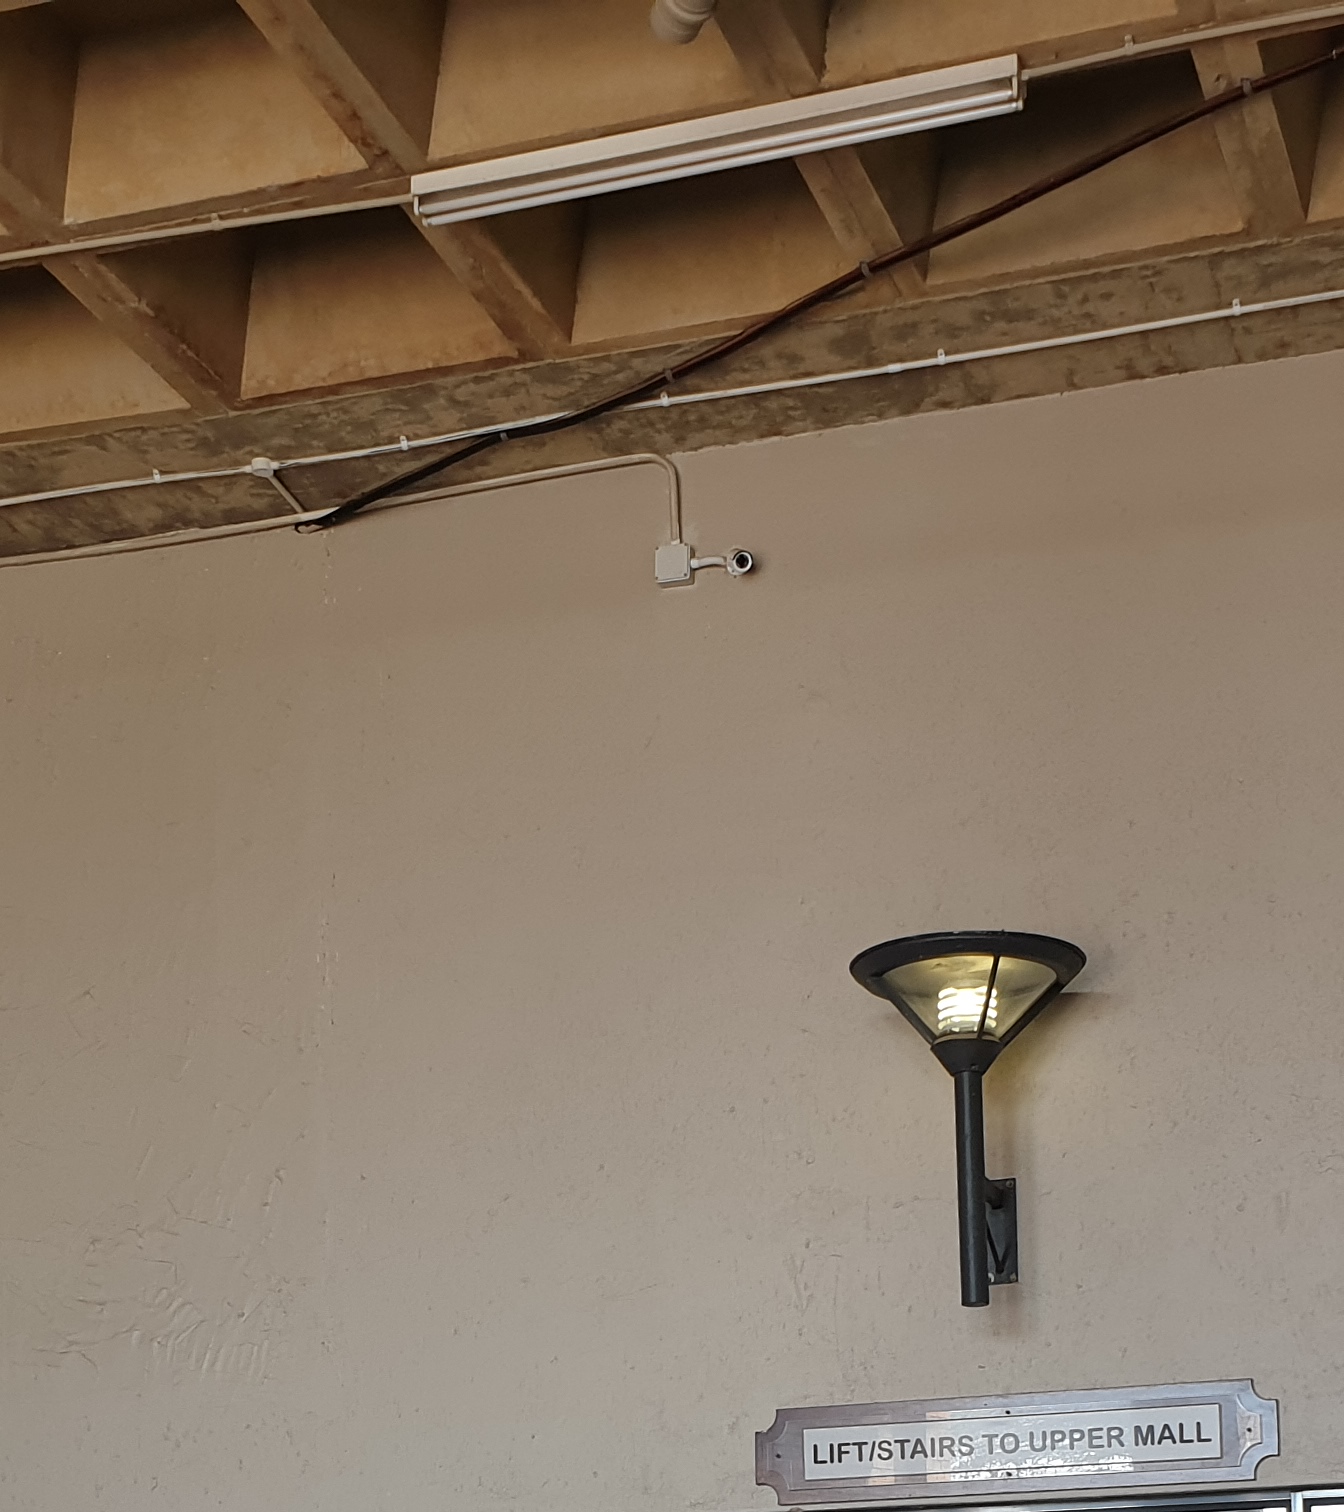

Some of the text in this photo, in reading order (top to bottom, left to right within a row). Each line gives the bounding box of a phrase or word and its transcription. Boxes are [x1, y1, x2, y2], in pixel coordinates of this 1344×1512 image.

[811, 1421, 1213, 1466] LIFT/STAIRS TO UPPER MALL
